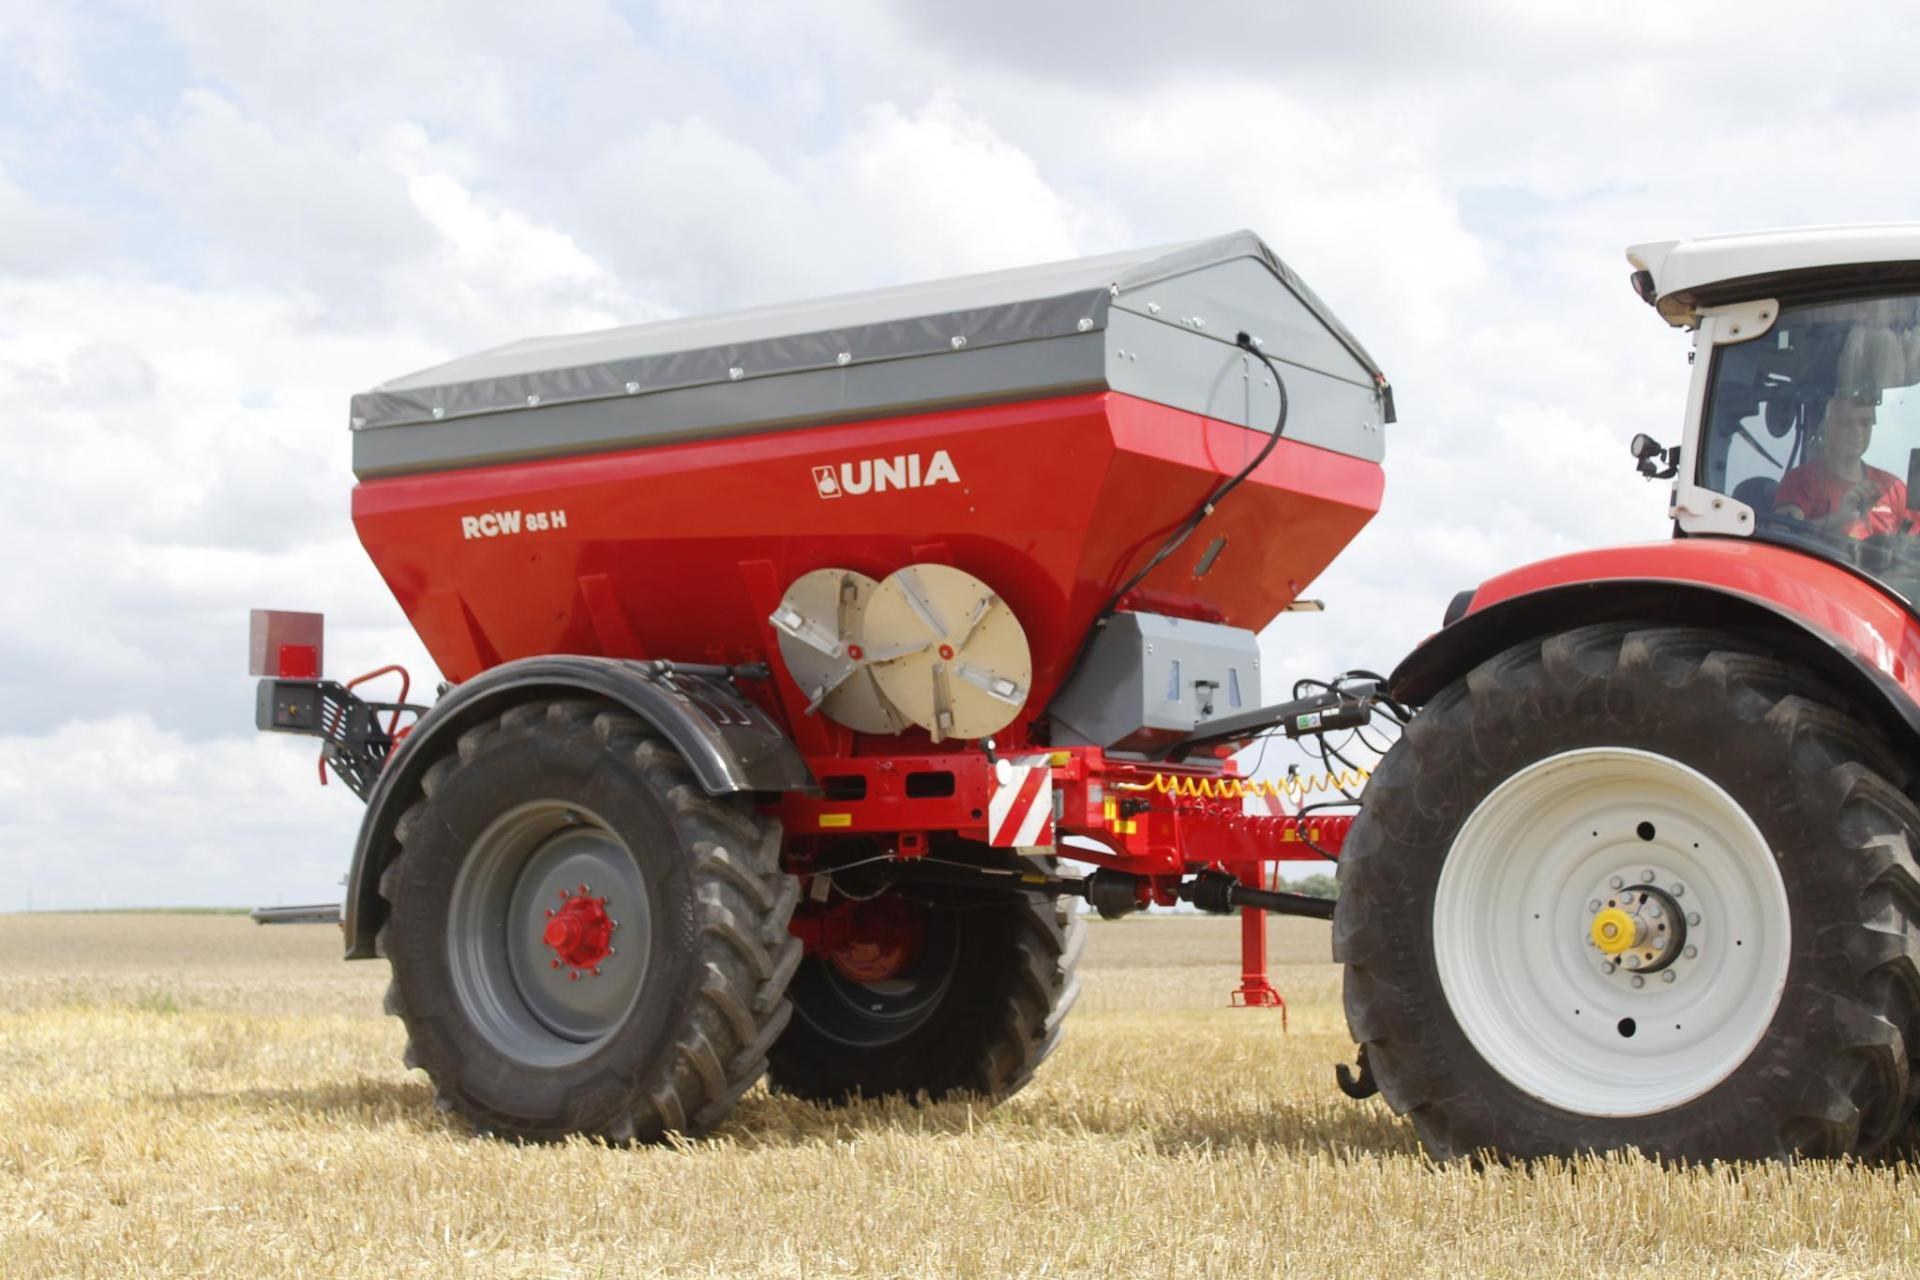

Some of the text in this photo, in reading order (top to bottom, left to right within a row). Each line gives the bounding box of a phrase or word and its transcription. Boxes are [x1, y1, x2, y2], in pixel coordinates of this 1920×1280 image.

[840, 450, 961, 495] UNIA
[462, 510, 567, 540] RCW 85 H
